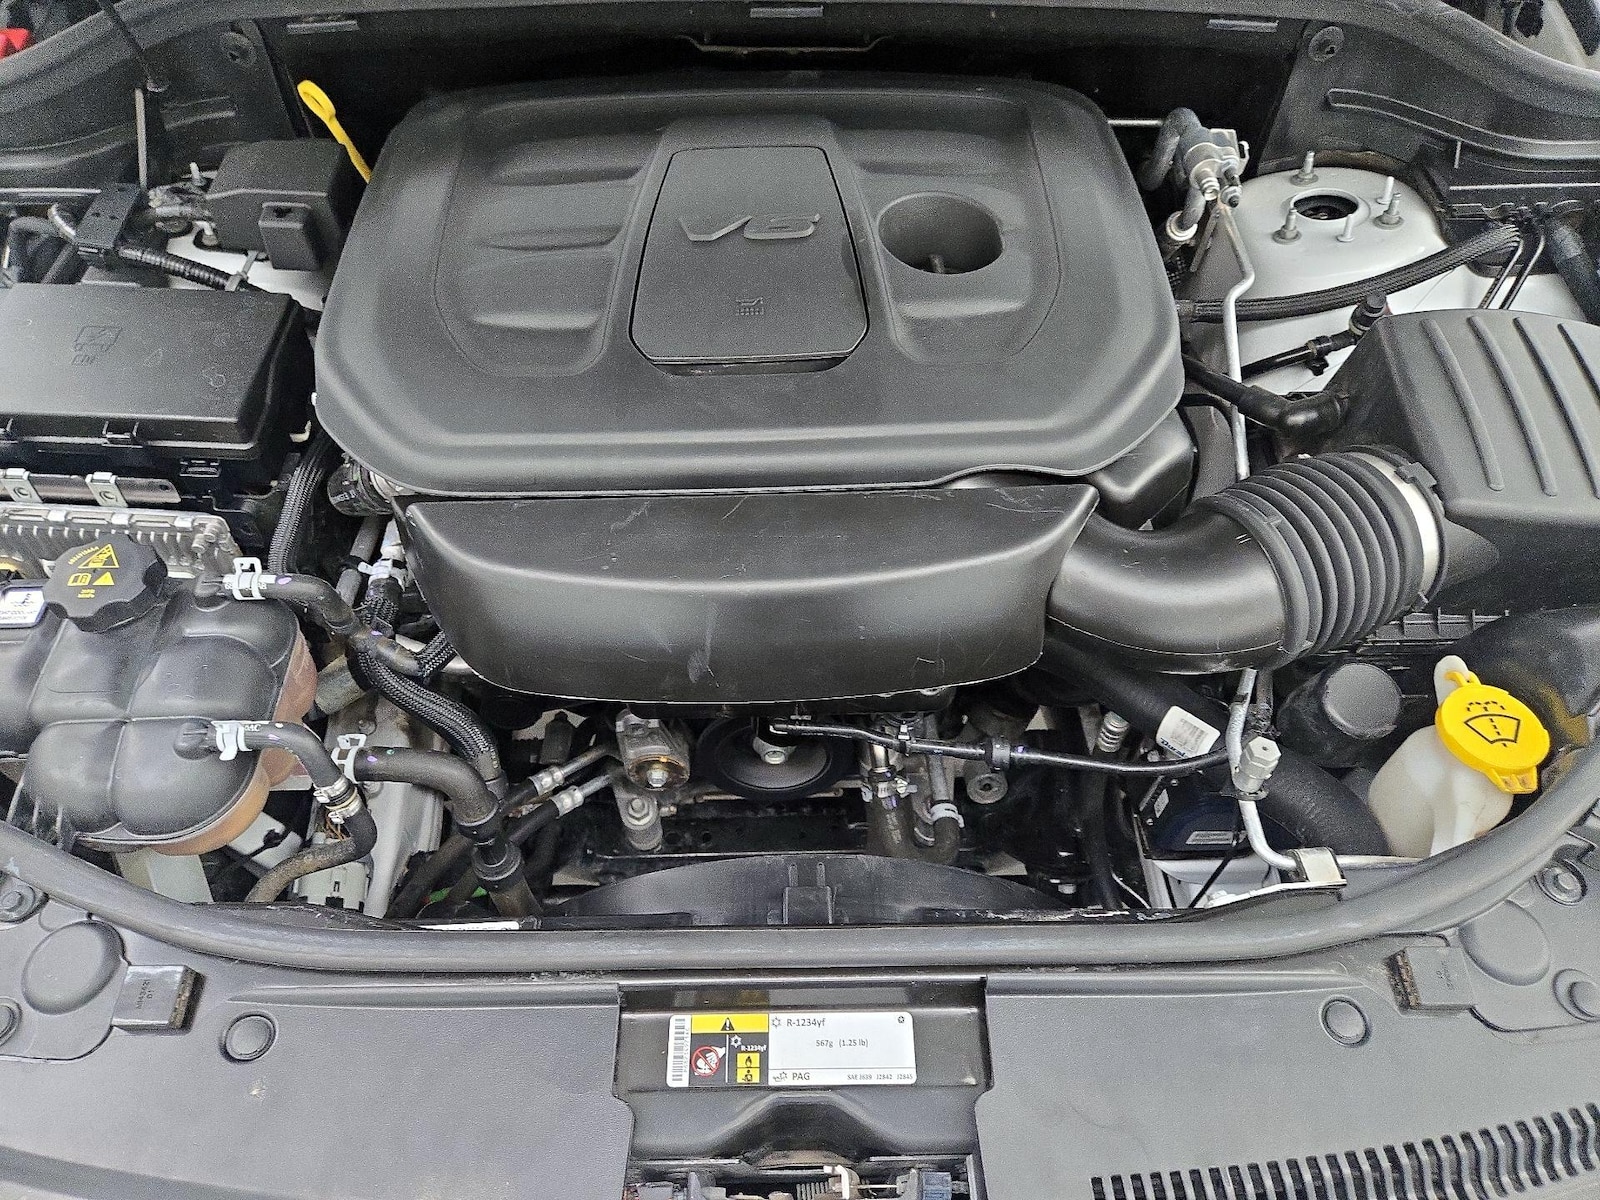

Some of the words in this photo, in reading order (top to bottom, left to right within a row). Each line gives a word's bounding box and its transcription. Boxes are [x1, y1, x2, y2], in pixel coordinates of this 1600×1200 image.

[678, 213, 822, 242] V6
[786, 1018, 826, 1029] R-1234yf
[815, 1039, 834, 1049] 567g
[838, 1038, 858, 1048] (1.25
[792, 1071, 811, 1081] PAG
